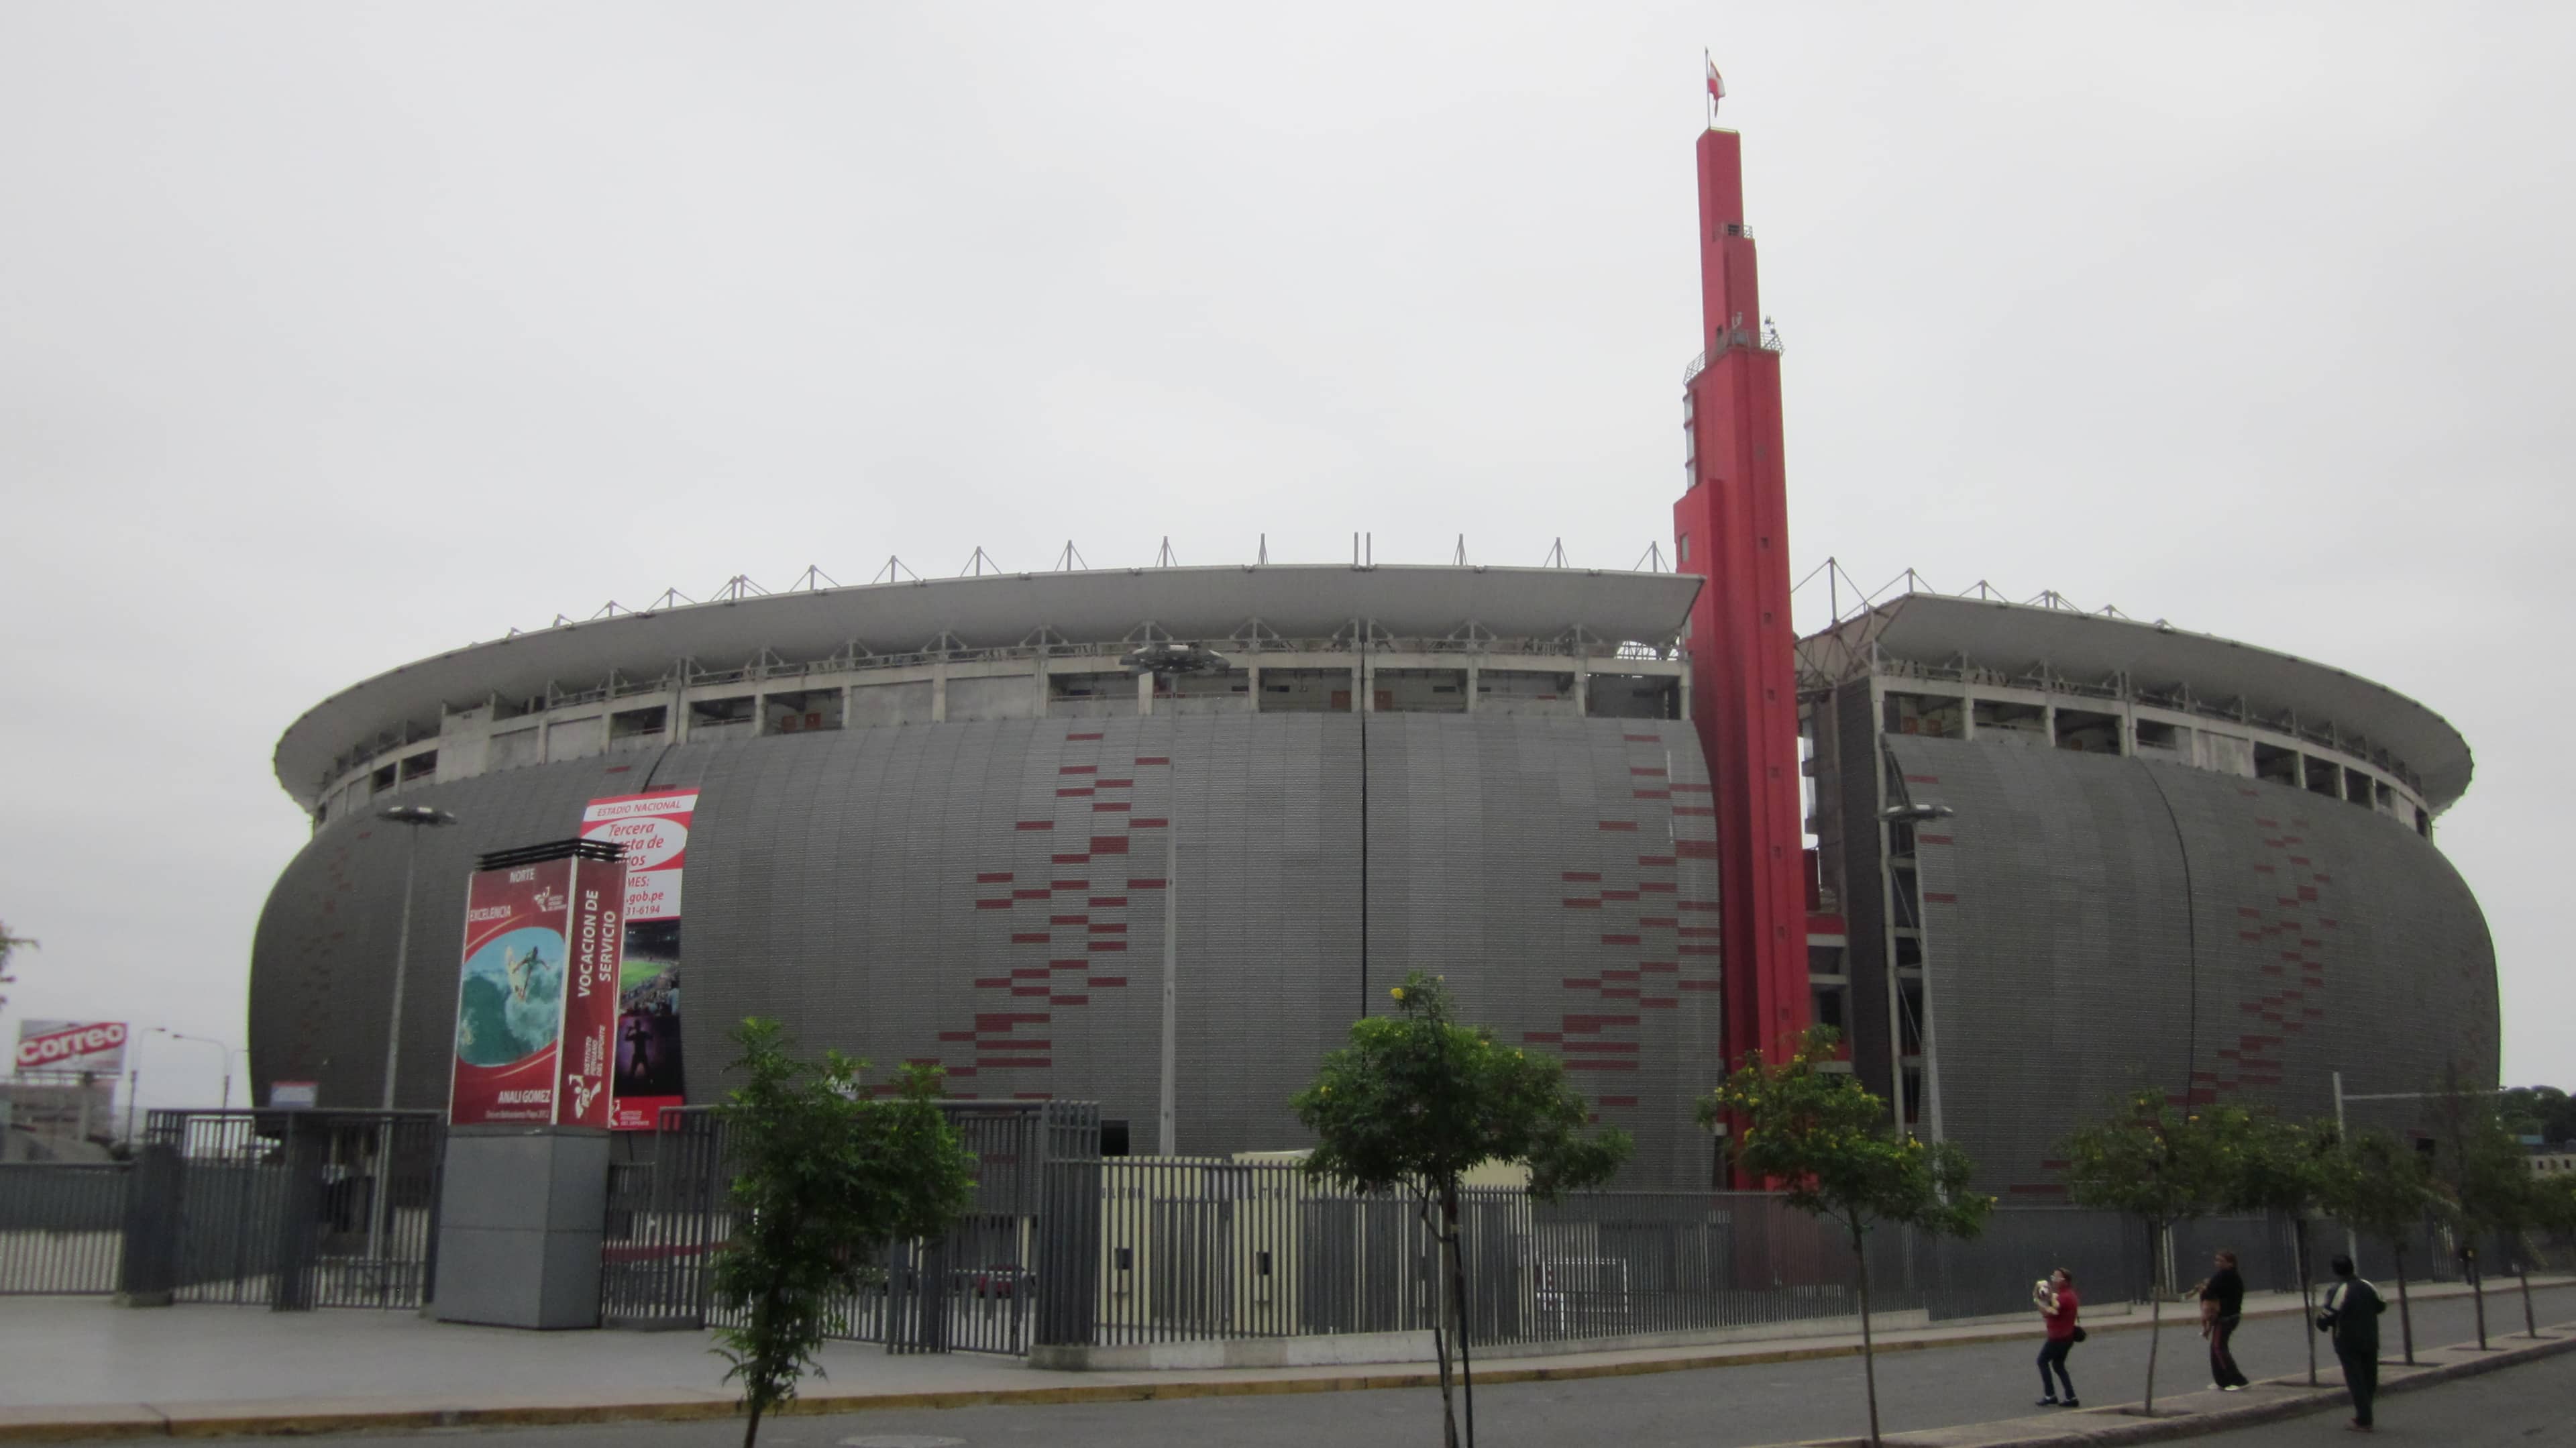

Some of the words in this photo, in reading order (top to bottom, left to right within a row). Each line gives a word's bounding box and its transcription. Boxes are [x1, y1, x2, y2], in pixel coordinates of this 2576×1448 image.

[597, 805, 631, 817] ESTADIO
[634, 800, 681, 812] NACIONAL
[608, 823, 655, 837] Tercera
[647, 834, 664, 848] de
[510, 868, 535, 883] NORTE
[585, 890, 599, 911] DE
[626, 891, 664, 905] .gob.pe
[470, 904, 512, 922] EXCELENCIA
[625, 906, 661, 916] 31-6194
[599, 911, 616, 982] SERVICIO
[578, 914, 597, 998] VOCACION
[17, 1025, 125, 1063] Correo
[584, 1035, 592, 1076] INSTITUTO
[498, 1090, 522, 1104] ANALI
[523, 1089, 551, 1104] GOMEZ
